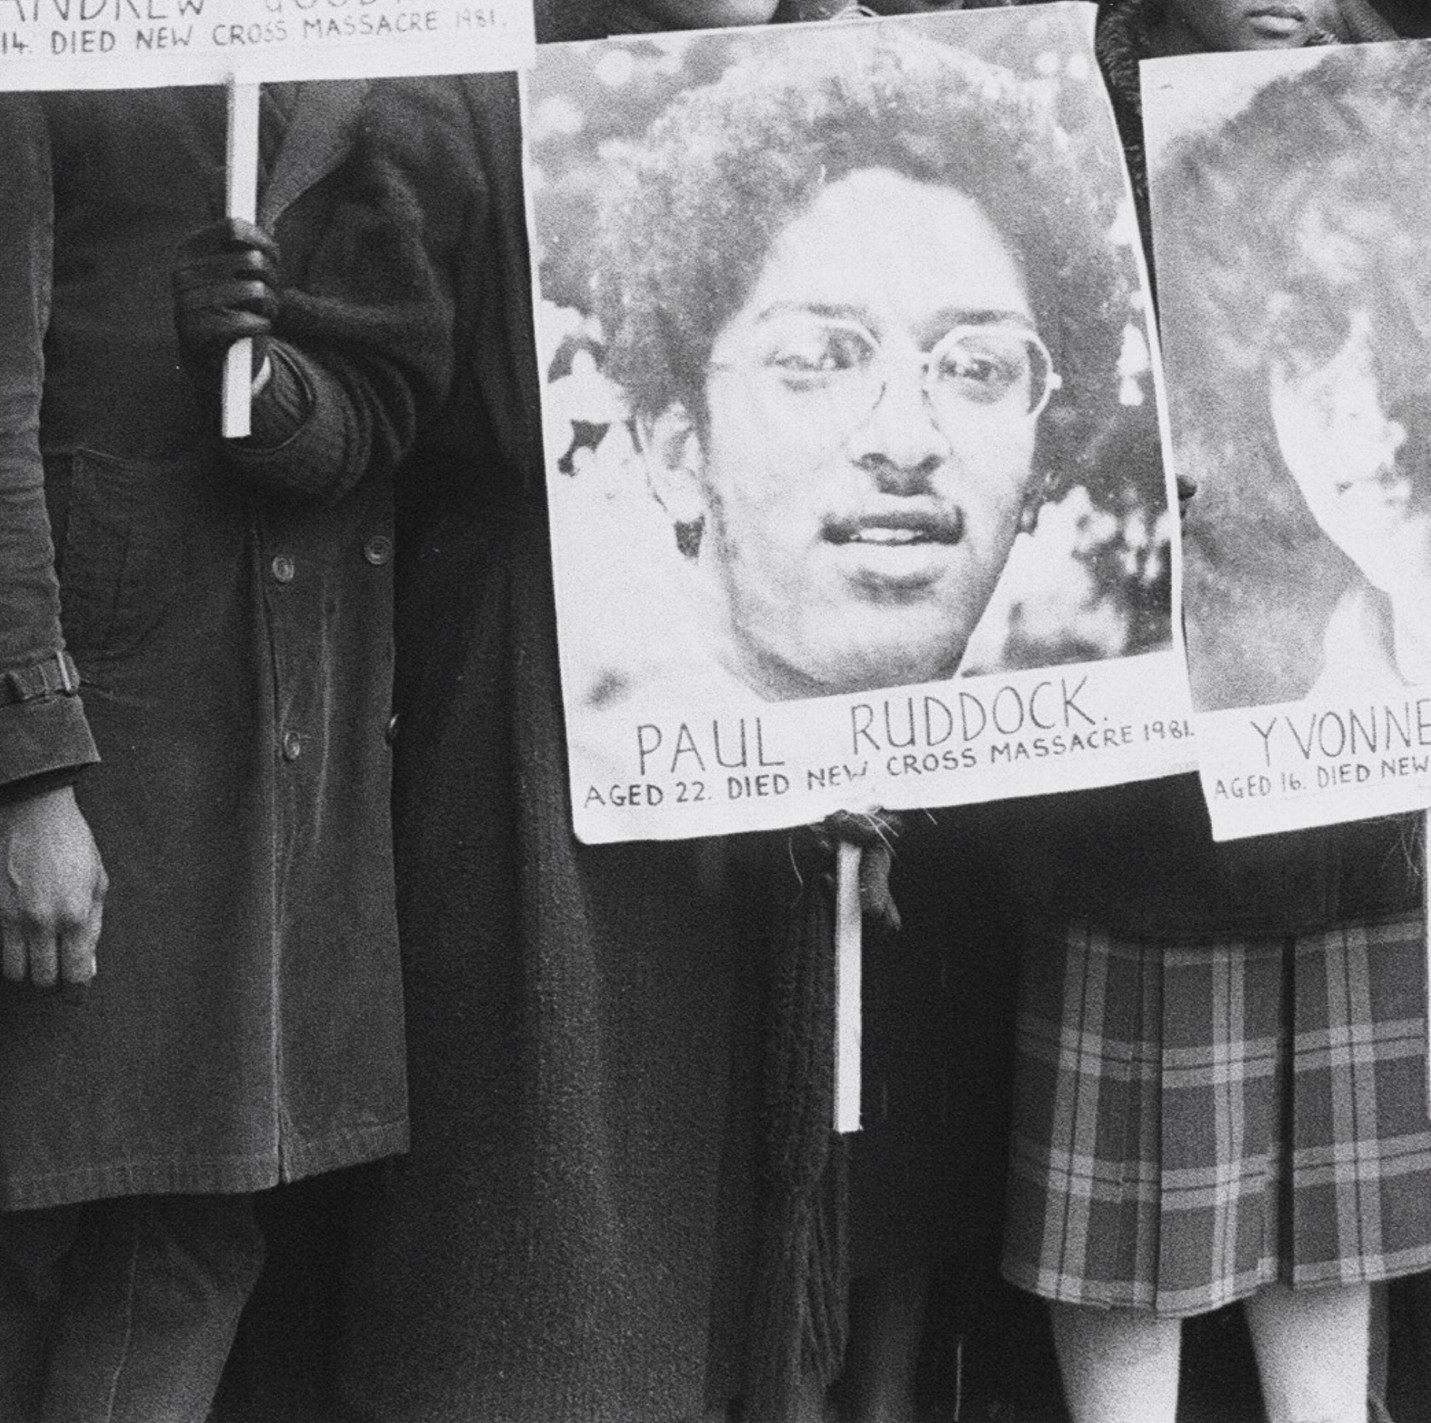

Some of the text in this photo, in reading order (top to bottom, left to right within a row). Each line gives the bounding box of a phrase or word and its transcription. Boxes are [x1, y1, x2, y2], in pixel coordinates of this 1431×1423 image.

[51, 29, 116, 55] DIED
[136, 24, 193, 50] NEW
[212, 20, 288, 47] CROSS
[303, 10, 439, 39] MASSACRE
[583, 776, 665, 810] AGED
[727, 773, 790, 800] DIED
[806, 759, 870, 792] NEW
[886, 748, 978, 777] CROSS
[990, 723, 1134, 766] MASSACRE
[636, 717, 786, 776] PAUL
[1213, 777, 1273, 801] AGED
[1316, 765, 1370, 789] DIED
[1381, 755, 1430, 778] NEW
